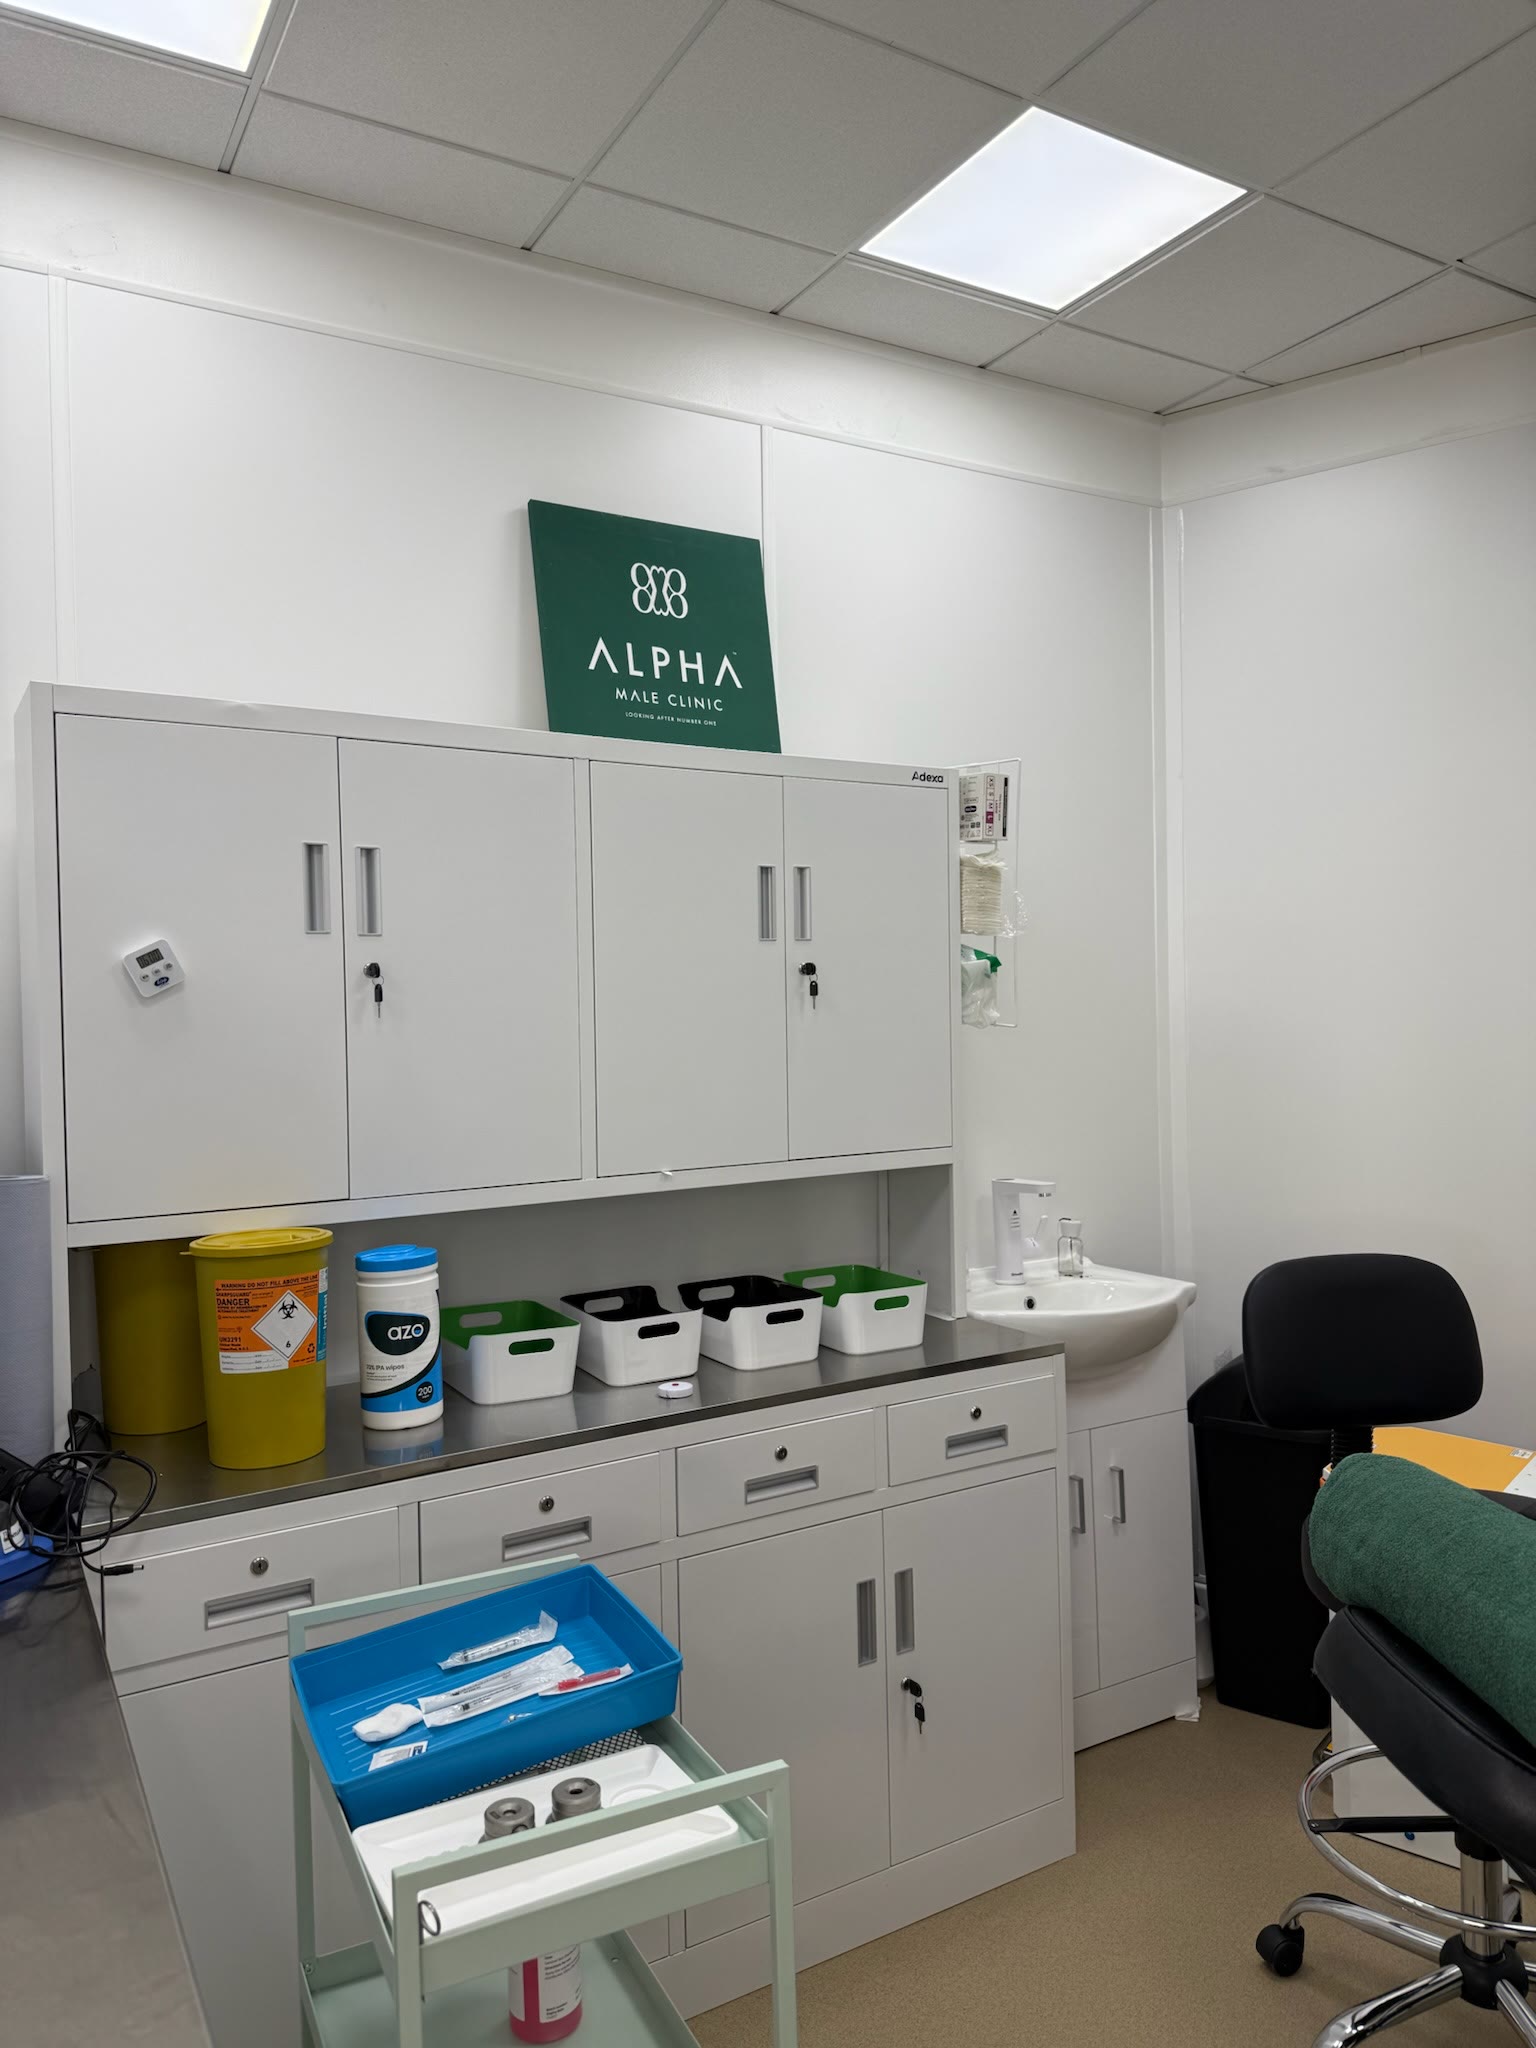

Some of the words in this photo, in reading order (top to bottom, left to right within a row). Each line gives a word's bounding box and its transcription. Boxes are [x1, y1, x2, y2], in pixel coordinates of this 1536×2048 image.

[588, 636, 743, 689] ALPHA
[615, 687, 659, 705] MALE
[667, 693, 723, 712] CLINIC
[625, 711, 655, 720] LOOKING
[676, 717, 702, 725] NUMBER
[911, 770, 944, 783] Adexa
[221, 1281, 246, 1289] WARNING
[283, 1277, 300, 1285] ABOVE
[216, 1298, 250, 1306] DANGER
[387, 1323, 424, 1341] azo
[285, 1340, 291, 1348] 6
[385, 1364, 405, 1372] wipes
[417, 1385, 433, 1397] 200
